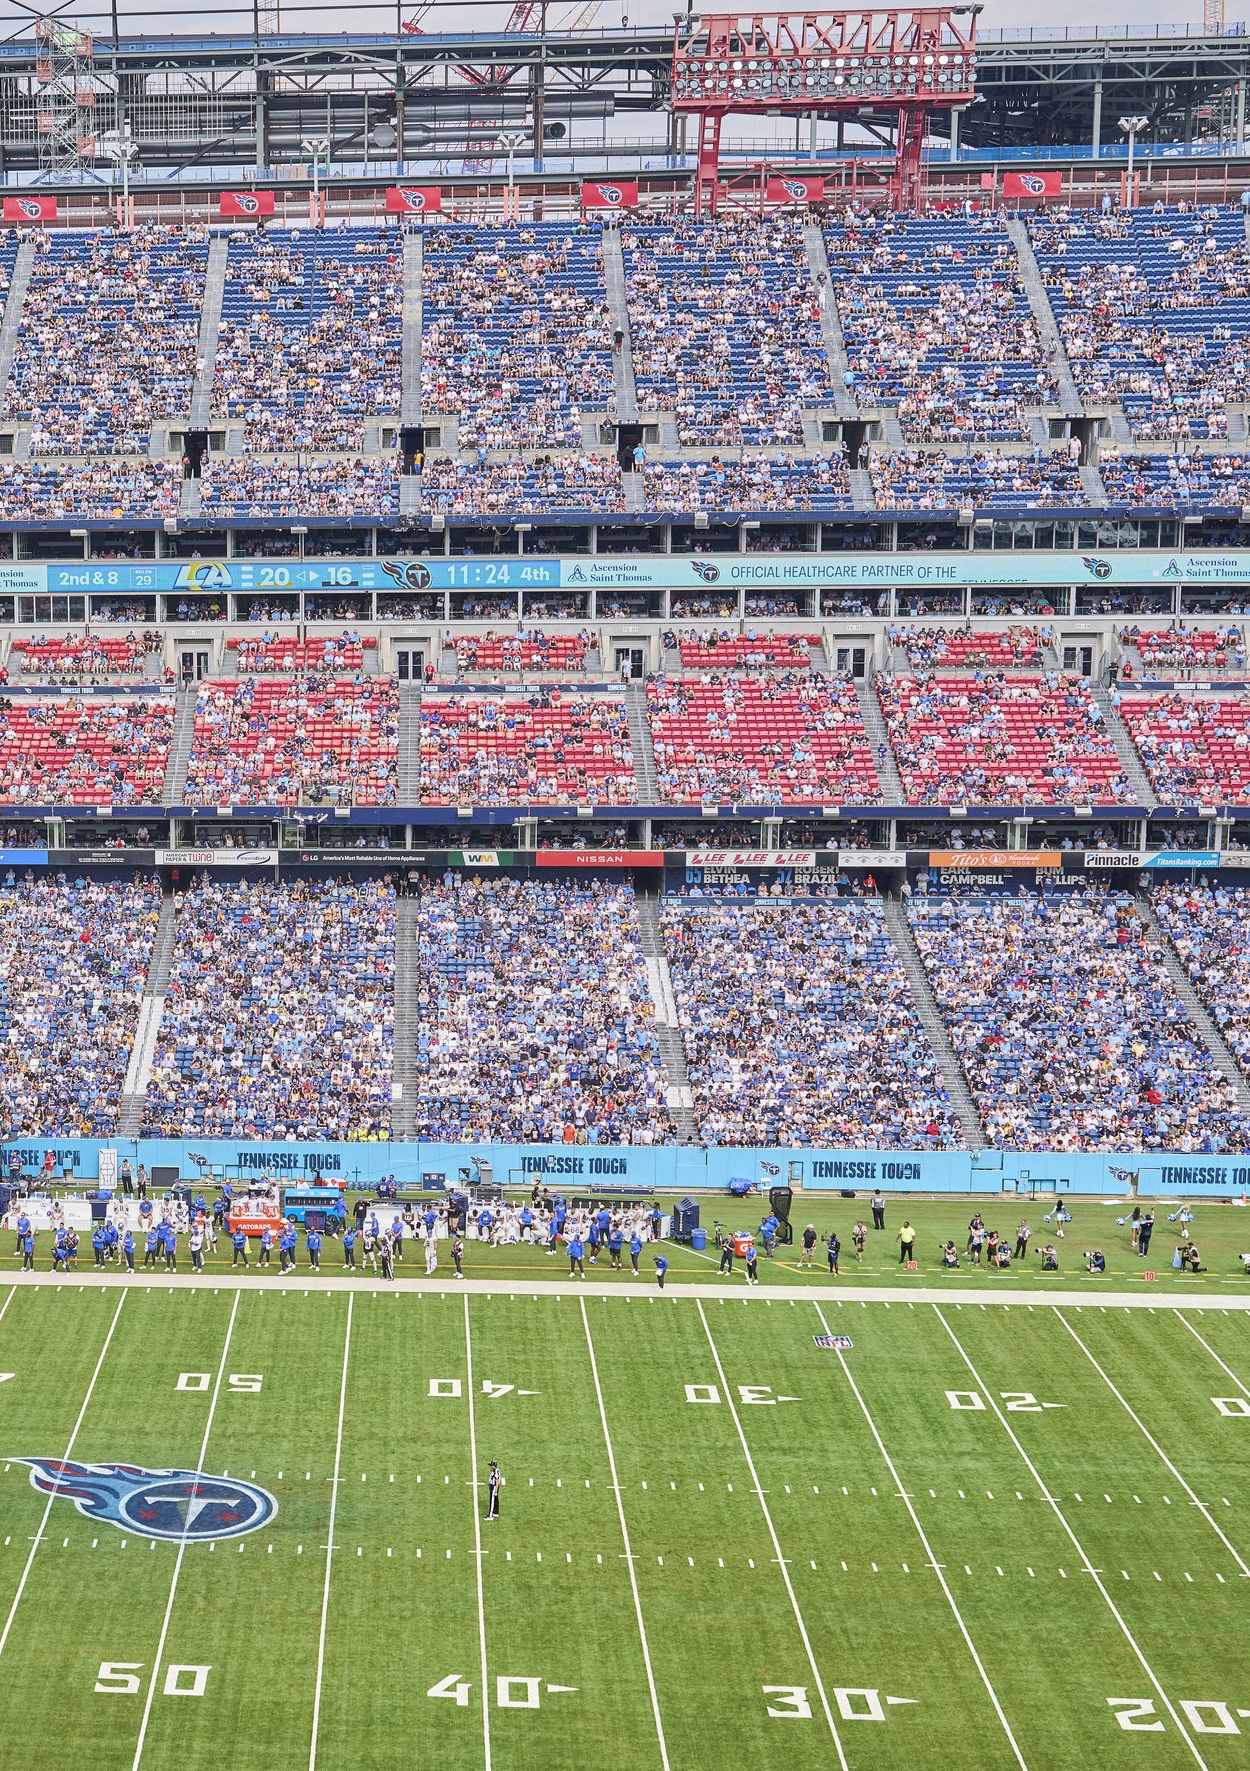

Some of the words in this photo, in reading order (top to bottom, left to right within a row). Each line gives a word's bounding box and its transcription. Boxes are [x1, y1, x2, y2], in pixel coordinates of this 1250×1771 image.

[590, 564, 638, 572] Ascension
[1187, 558, 1237, 566] Ascension
[260, 567, 290, 586] 20
[327, 567, 352, 585] 16
[447, 564, 510, 584] 11:24
[520, 566, 550, 581] 4th
[590, 574, 614, 582] Saint
[616, 573, 652, 582] Thomas
[731, 566, 780, 578] OFFICIAL
[783, 566, 858, 578] HEALTHCARE
[862, 565, 914, 577] PARTNER
[917, 567, 934, 578] OF
[936, 566, 956, 578] THE
[1186, 568, 1211, 577] Saint
[4, 579, 38, 587] Thomas
[59, 572, 90, 585] 2nd
[92, 572, 105, 585] &
[107, 572, 118, 585] 8
[136, 575, 152, 586] 29
[468, 854, 494, 863] WM
[704, 853, 726, 862] LEE
[745, 853, 768, 862] LEE
[787, 853, 809, 862] LEE
[950, 854, 988, 866] Tito's
[1086, 854, 1140, 866] Pinnacle
[1157, 858, 1218, 867] TitansBanking.com
[685, 866, 701, 884] 65
[704, 874, 750, 884] BETHEA
[794, 874, 842, 884] BRAZIL
[940, 874, 1004, 885] CAMPBELL
[1036, 875, 1086, 885] PLLIPS
[237, 1152, 298, 1170] TENNESSEE
[303, 1153, 341, 1170] TOUGH
[520, 1156, 584, 1174] TENNESSEE
[588, 1157, 627, 1175] TOUGH
[812, 1161, 876, 1180] TENNESSEE
[881, 1162, 922, 1180] TOUGH
[1161, 1166, 1227, 1185] TENNESSEE
[740, 1243, 749, 1252] G
[174, 1373, 264, 1393] 50
[427, 1379, 515, 1398] 40
[684, 1384, 778, 1404] 30
[944, 1390, 1043, 1411] 20
[94, 1662, 212, 1696] 50
[426, 1674, 542, 1709] 40
[762, 1685, 886, 1721] 30
[1106, 1698, 1241, 1734] 20
